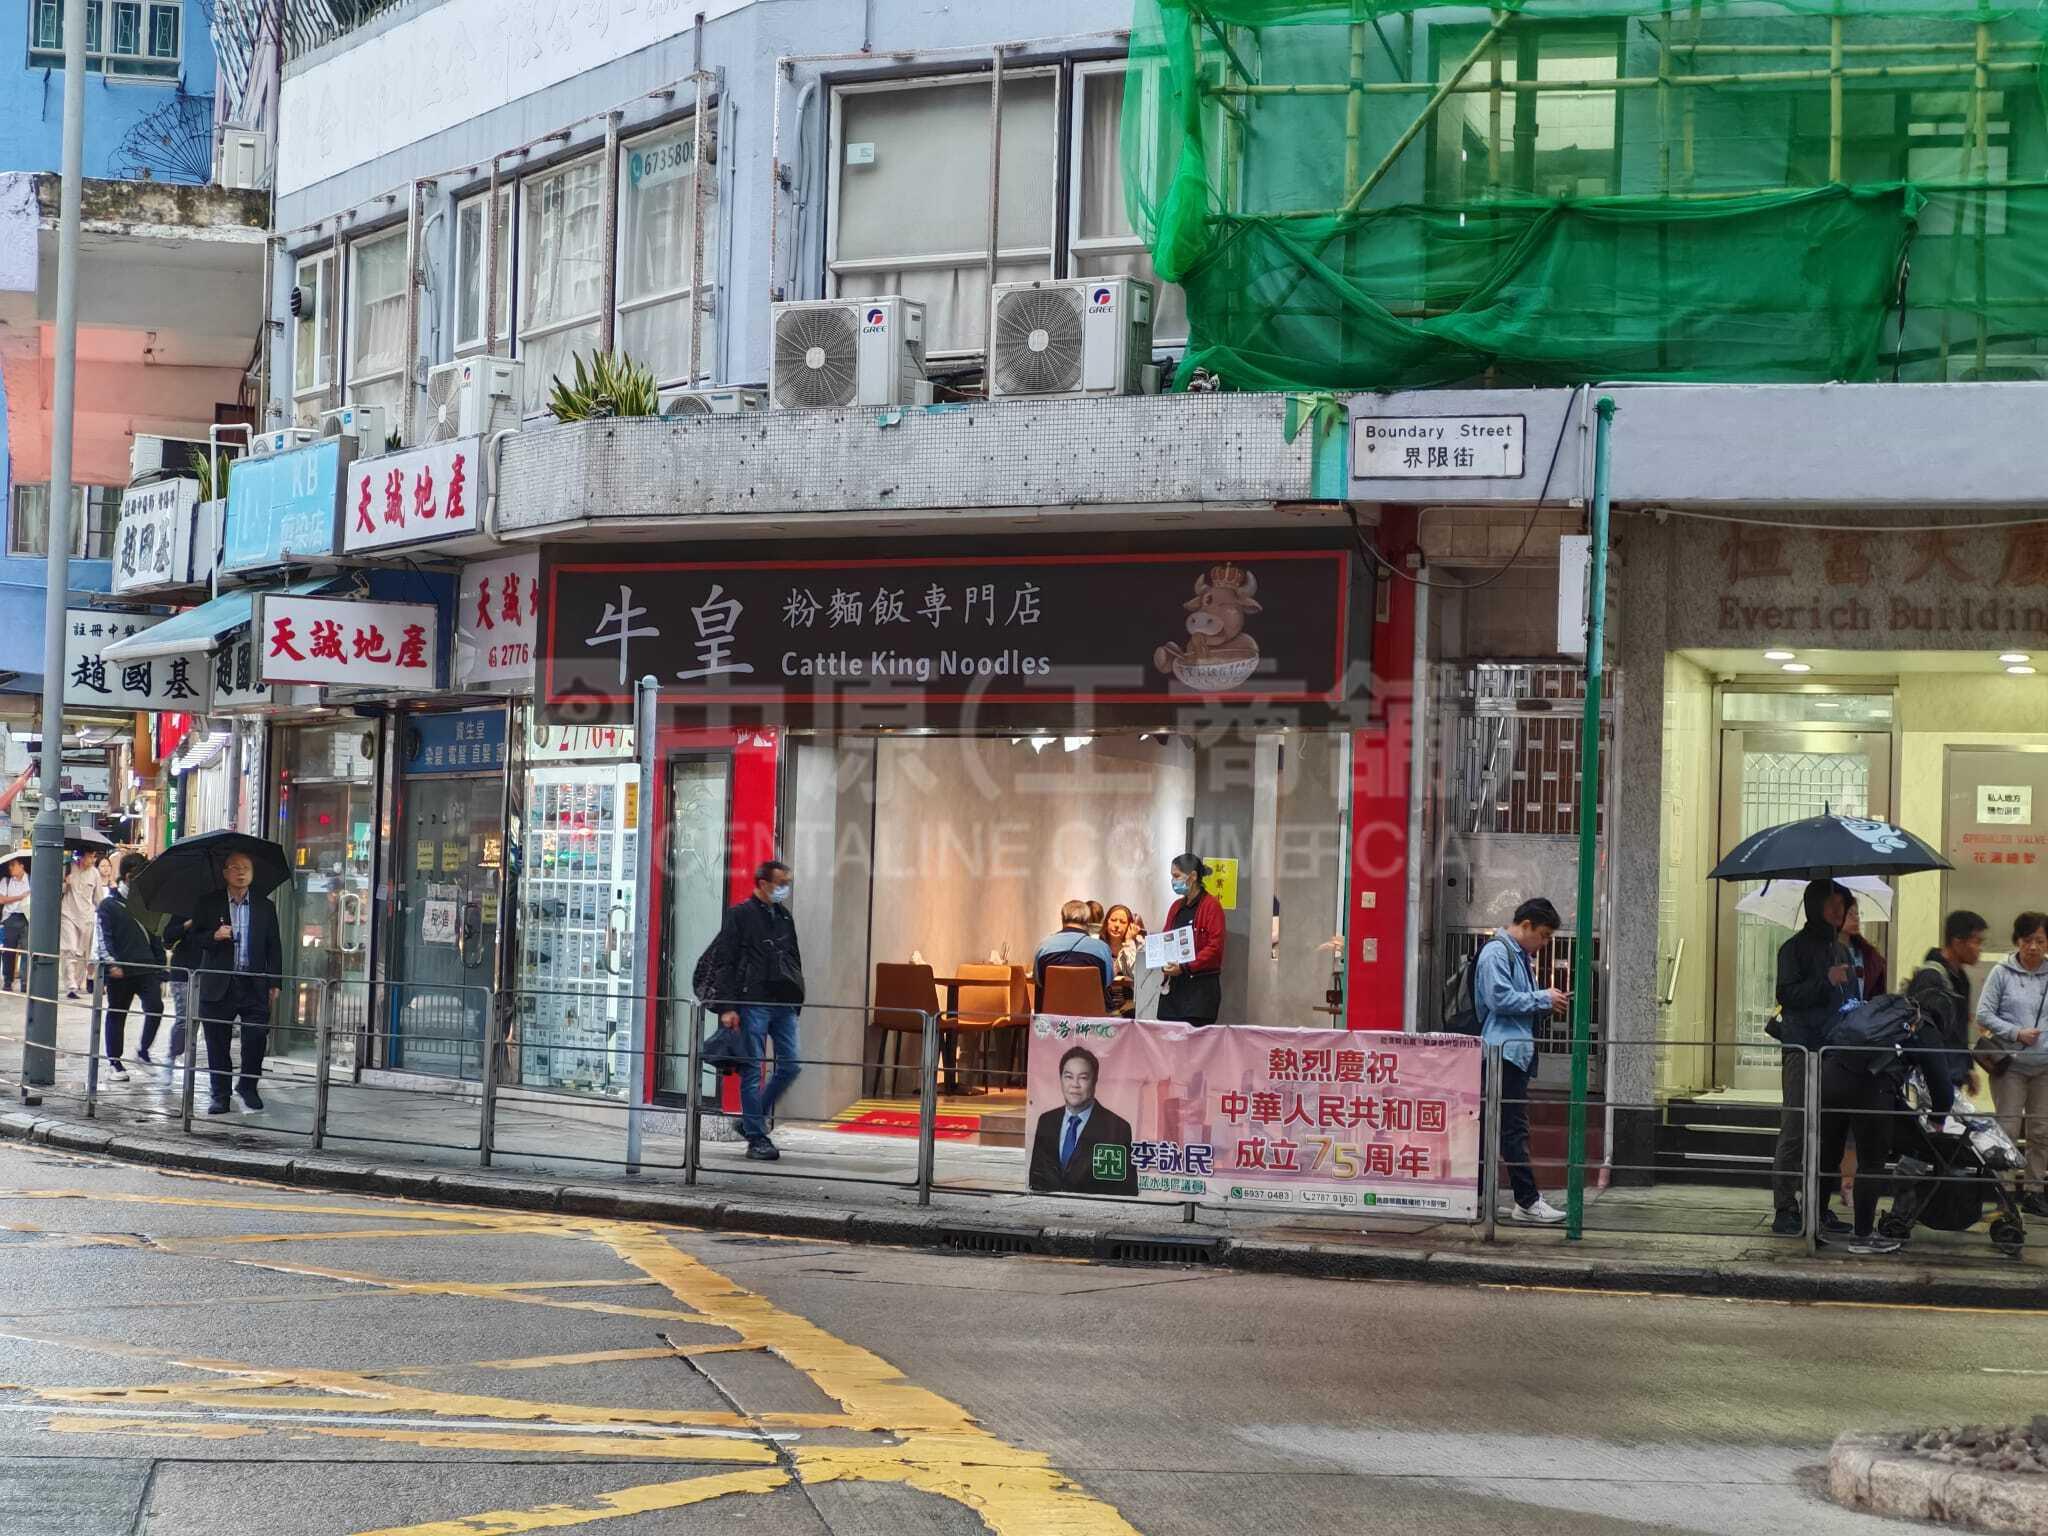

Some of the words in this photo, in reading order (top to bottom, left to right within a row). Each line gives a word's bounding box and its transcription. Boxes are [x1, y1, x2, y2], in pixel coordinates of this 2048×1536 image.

[1088, 305, 1117, 314] GREE
[863, 325, 887, 334] GREE
[1366, 425, 1444, 440] Boundary
[1460, 424, 1512, 437] Street
[1403, 446, 1474, 468] 界限街
[356, 453, 466, 533] 天誠地產
[1718, 594, 1871, 631] Everich
[73, 622, 146, 640] 註冊中醫
[270, 617, 428, 668] 天誠地產
[585, 584, 754, 686] 牛皇
[501, 643, 528, 666] 2776
[781, 650, 863, 676] Cattle
[871, 650, 930, 681] King
[940, 649, 1050, 675] Noodles
[71, 654, 199, 699] 趙國基
[1268, 1048, 1400, 1085] 熱烈慶祝
[1220, 1090, 1448, 1133] 中華人民共和國
[1131, 1140, 1213, 1176] 李詠民
